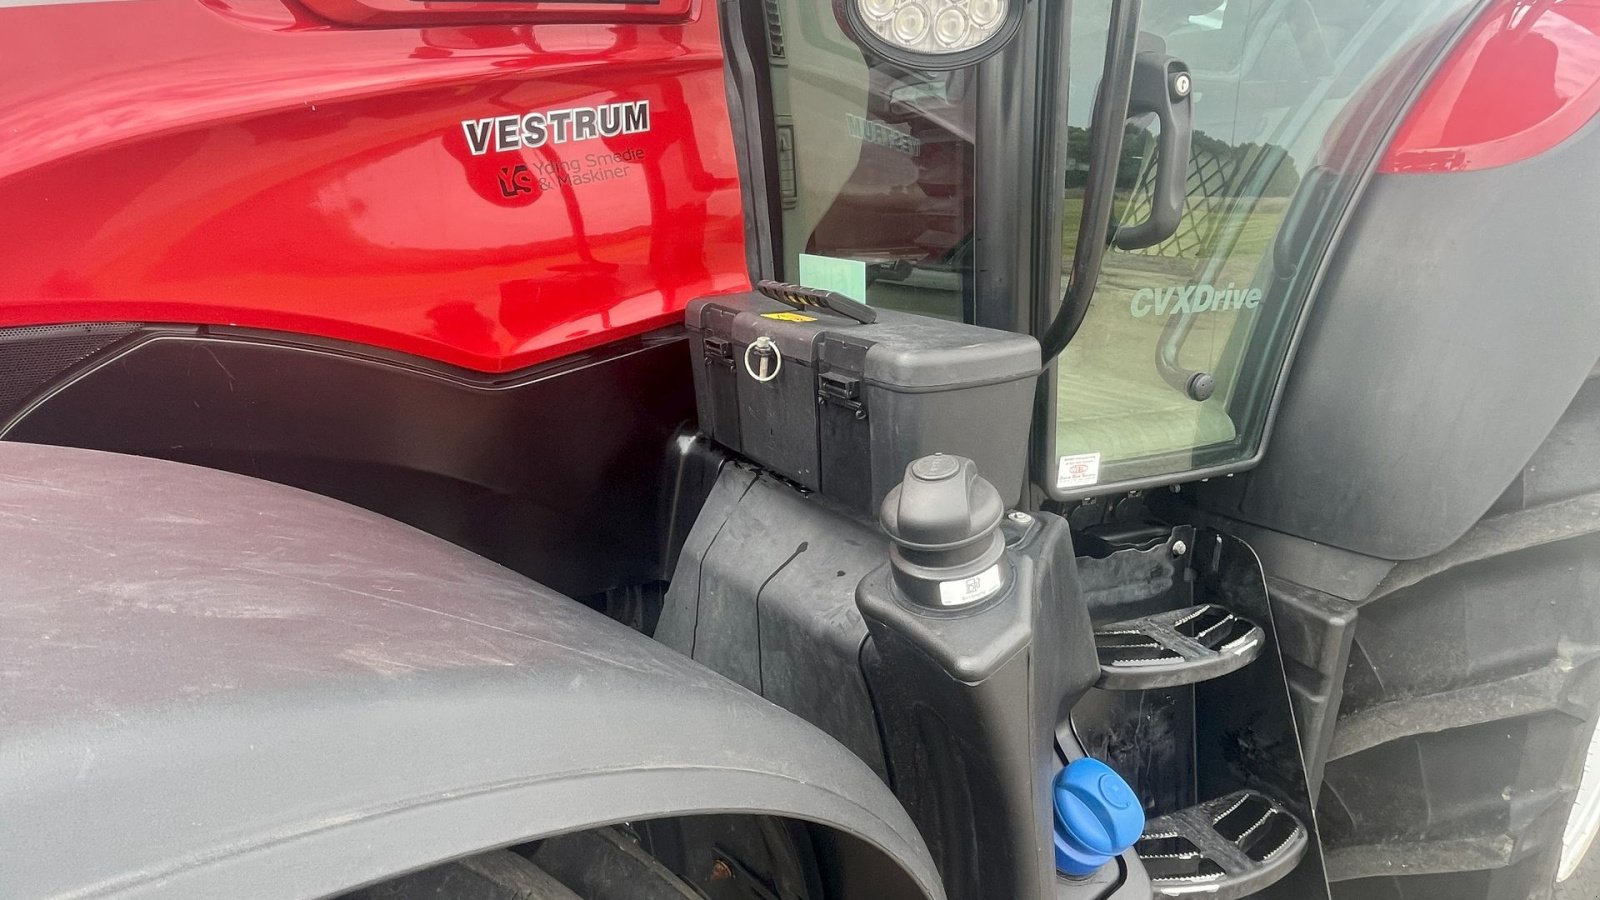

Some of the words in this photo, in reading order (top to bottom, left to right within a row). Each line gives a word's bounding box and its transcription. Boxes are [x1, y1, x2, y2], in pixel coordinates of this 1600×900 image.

[461, 100, 650, 156] VESTRUM
[533, 158, 581, 174] Yding
[586, 148, 645, 168] Smedie
[539, 176, 554, 192] &
[557, 165, 630, 188] Maskiner
[1130, 282, 1262, 318] CVXDrive
